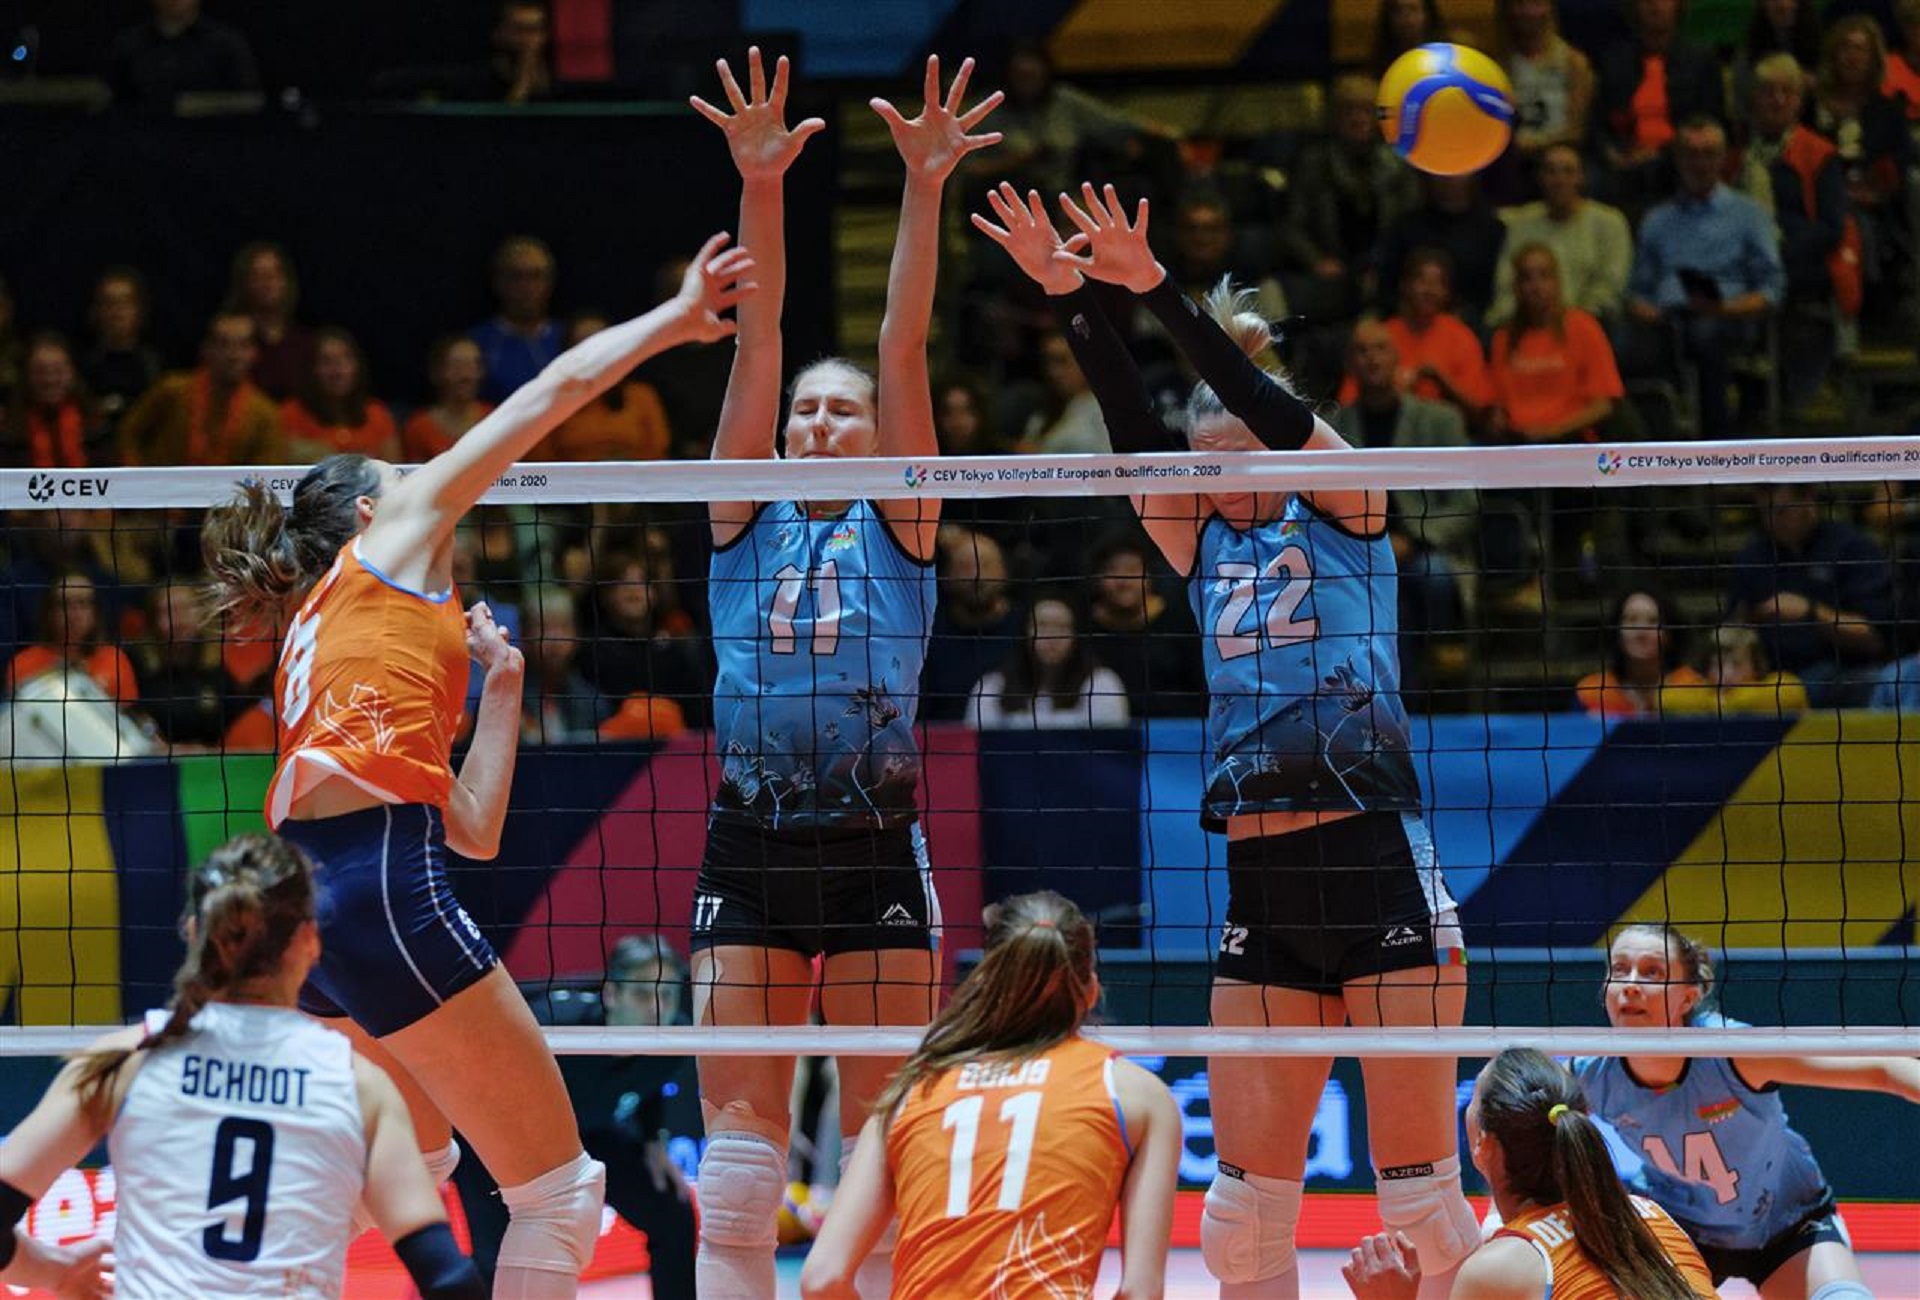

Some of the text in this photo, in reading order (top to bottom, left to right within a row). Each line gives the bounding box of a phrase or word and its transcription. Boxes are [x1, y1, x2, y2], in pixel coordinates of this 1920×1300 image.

[271, 478, 295, 490] CEV
[520, 474, 547, 487] 2020
[932, 464, 1222, 484] CEV Tokyo Volleyball European Qualification 2020
[1628, 449, 1920, 469] CEV Tokyo Volleyball European Qualification 20
[61, 478, 109, 497] CEV
[1213, 543, 1322, 663] 22
[181, 1055, 313, 1108] SCHOOT
[941, 1091, 1044, 1218] 11
[1641, 1129, 1741, 1206] 14
[203, 1115, 275, 1263] 9
